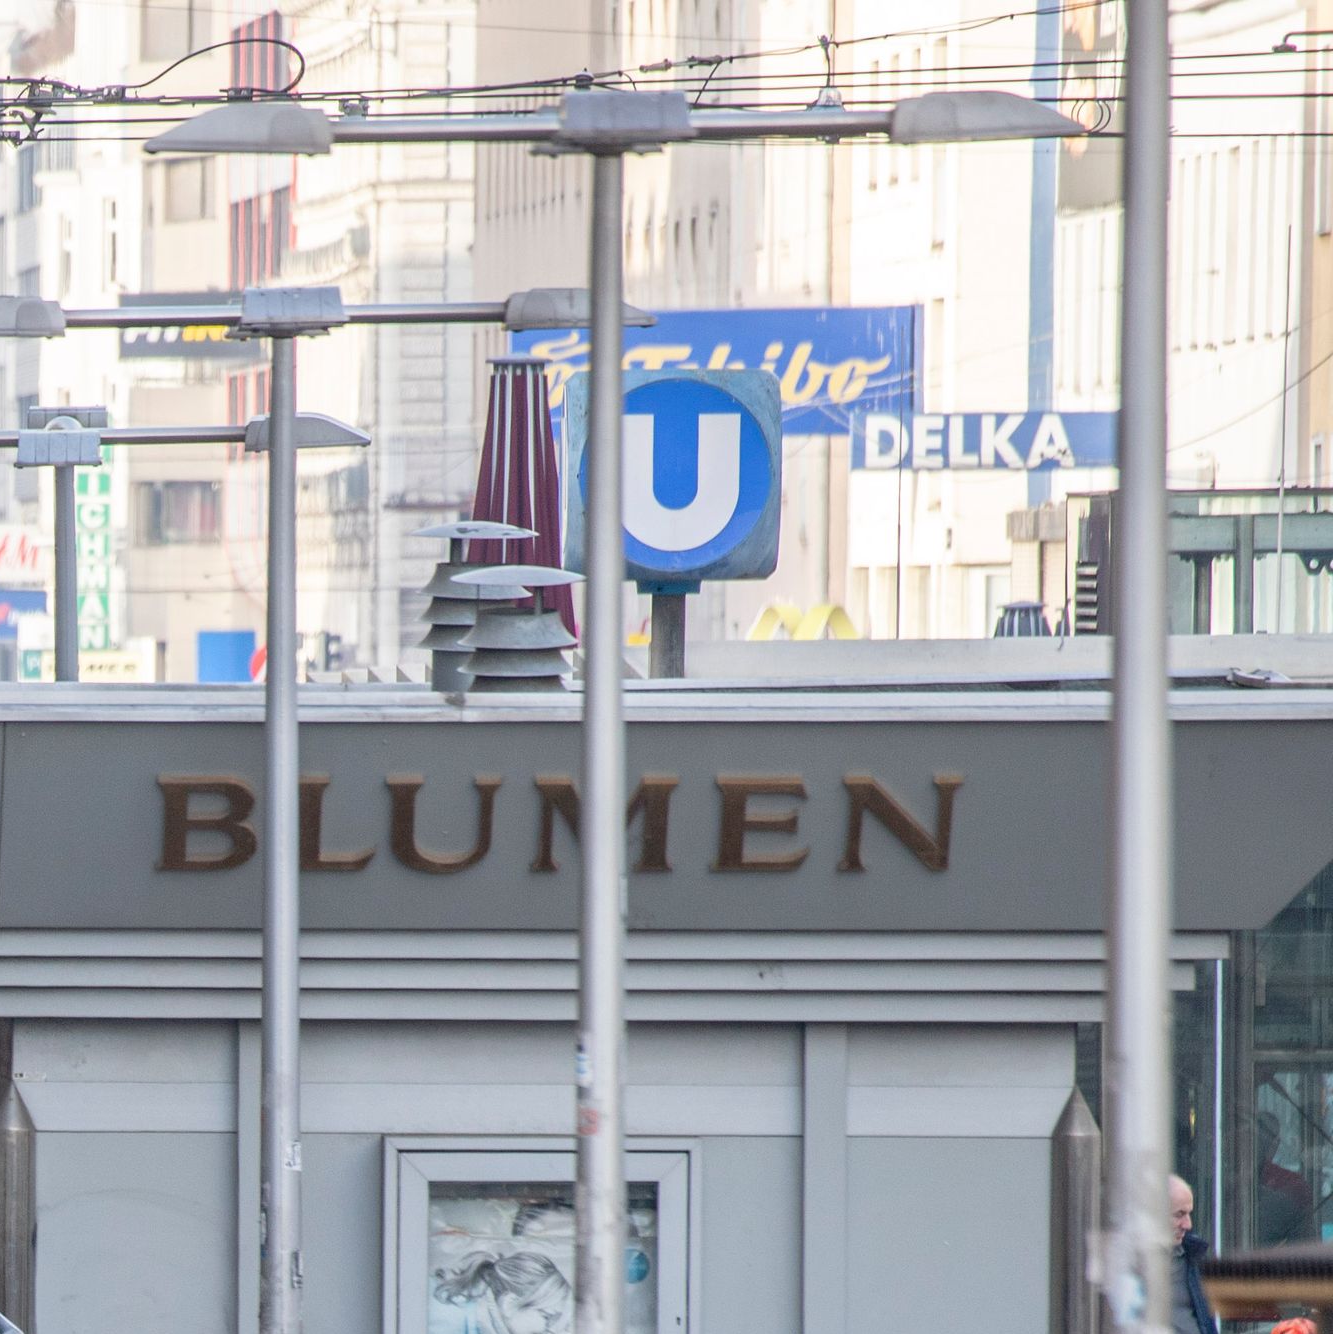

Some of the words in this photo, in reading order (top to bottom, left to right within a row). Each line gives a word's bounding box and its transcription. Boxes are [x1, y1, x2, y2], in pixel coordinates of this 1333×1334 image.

[622, 413, 741, 552] U
[865, 412, 1075, 470] DELKA
[155, 774, 965, 874] BLUMEN
